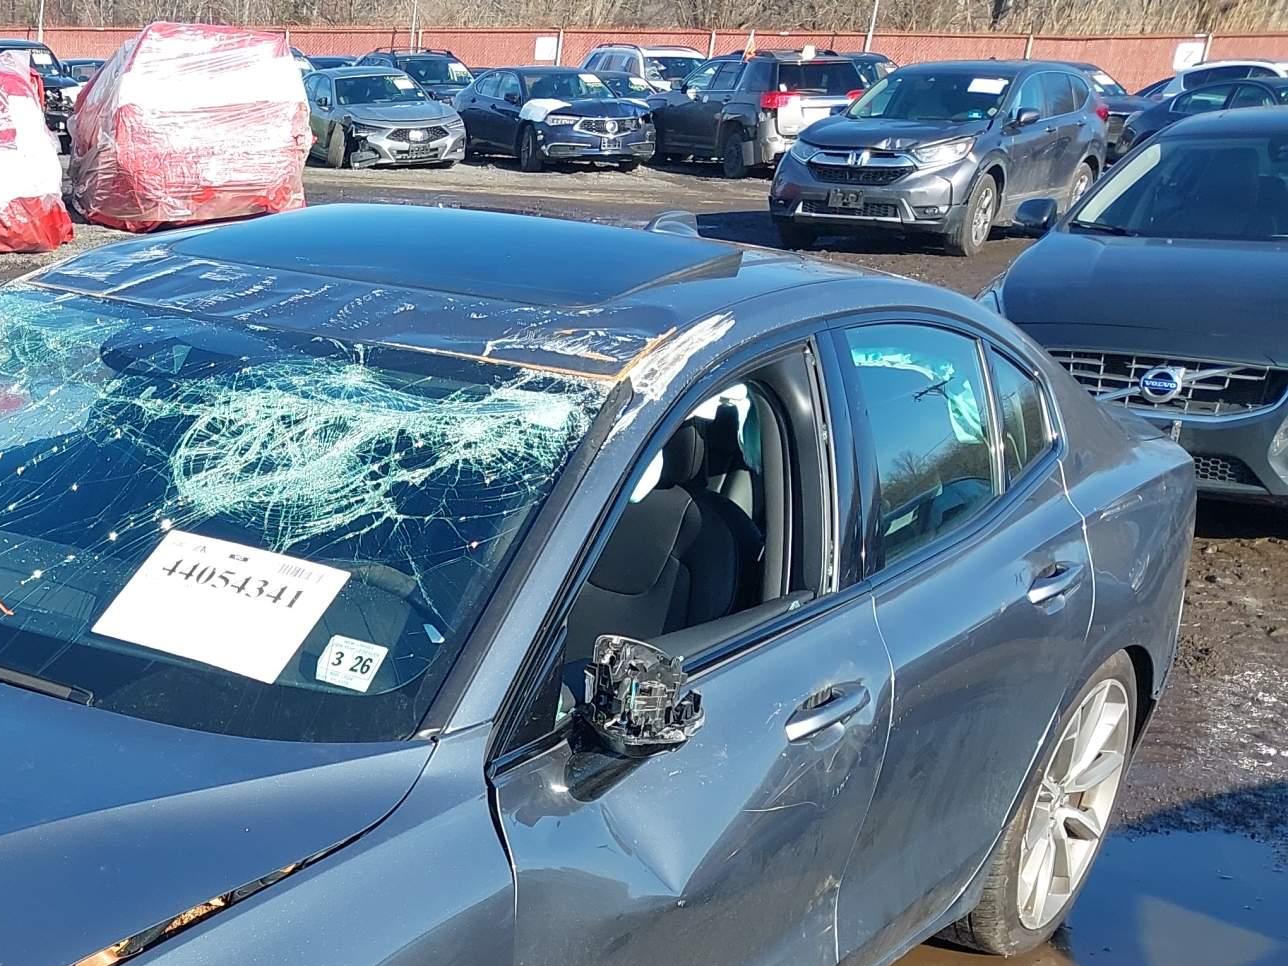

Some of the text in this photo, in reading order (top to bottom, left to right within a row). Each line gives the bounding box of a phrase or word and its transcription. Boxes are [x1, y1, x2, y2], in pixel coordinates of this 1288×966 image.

[1144, 380, 1177, 388] VOLVO
[163, 559, 303, 608] 44054341
[331, 651, 372, 674] 3 26
